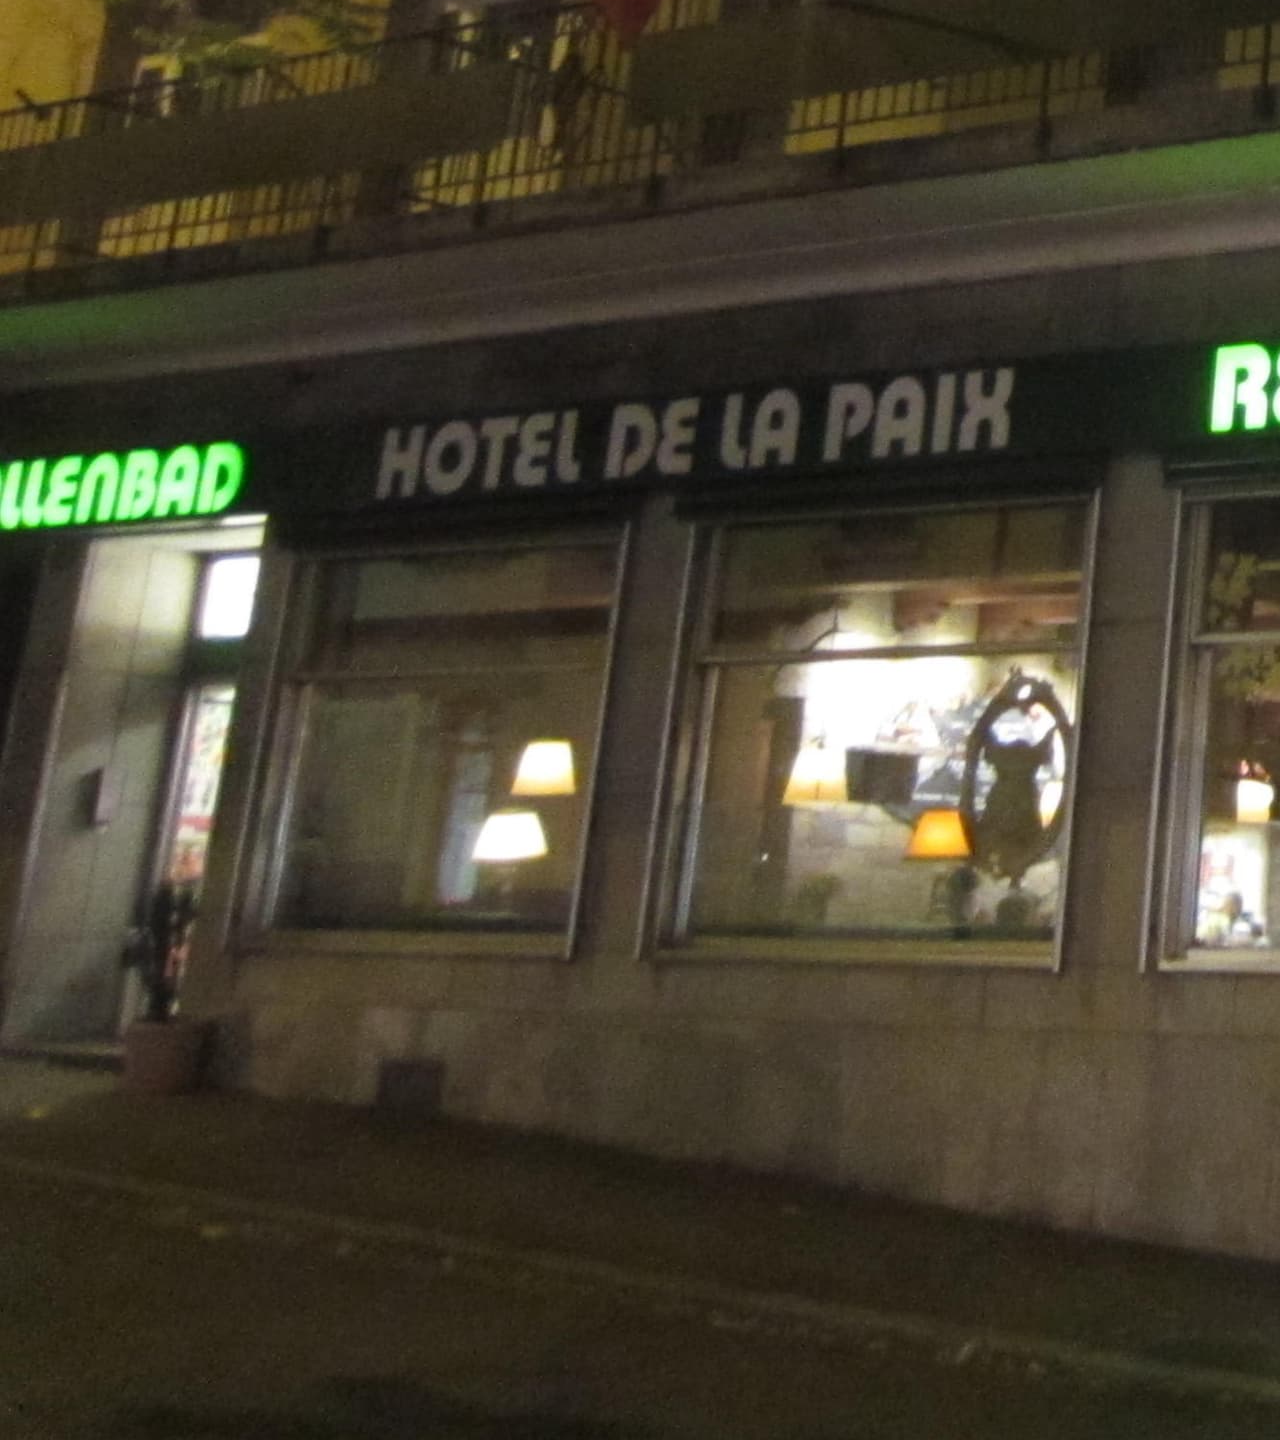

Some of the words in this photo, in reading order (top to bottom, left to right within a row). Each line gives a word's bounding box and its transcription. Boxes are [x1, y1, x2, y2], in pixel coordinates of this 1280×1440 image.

[0, 441, 243, 529] LLENBAD
[376, 407, 582, 500] HOTEL
[606, 396, 699, 478] DE
[720, 385, 801, 471] LA
[823, 368, 1016, 461] PAIX
